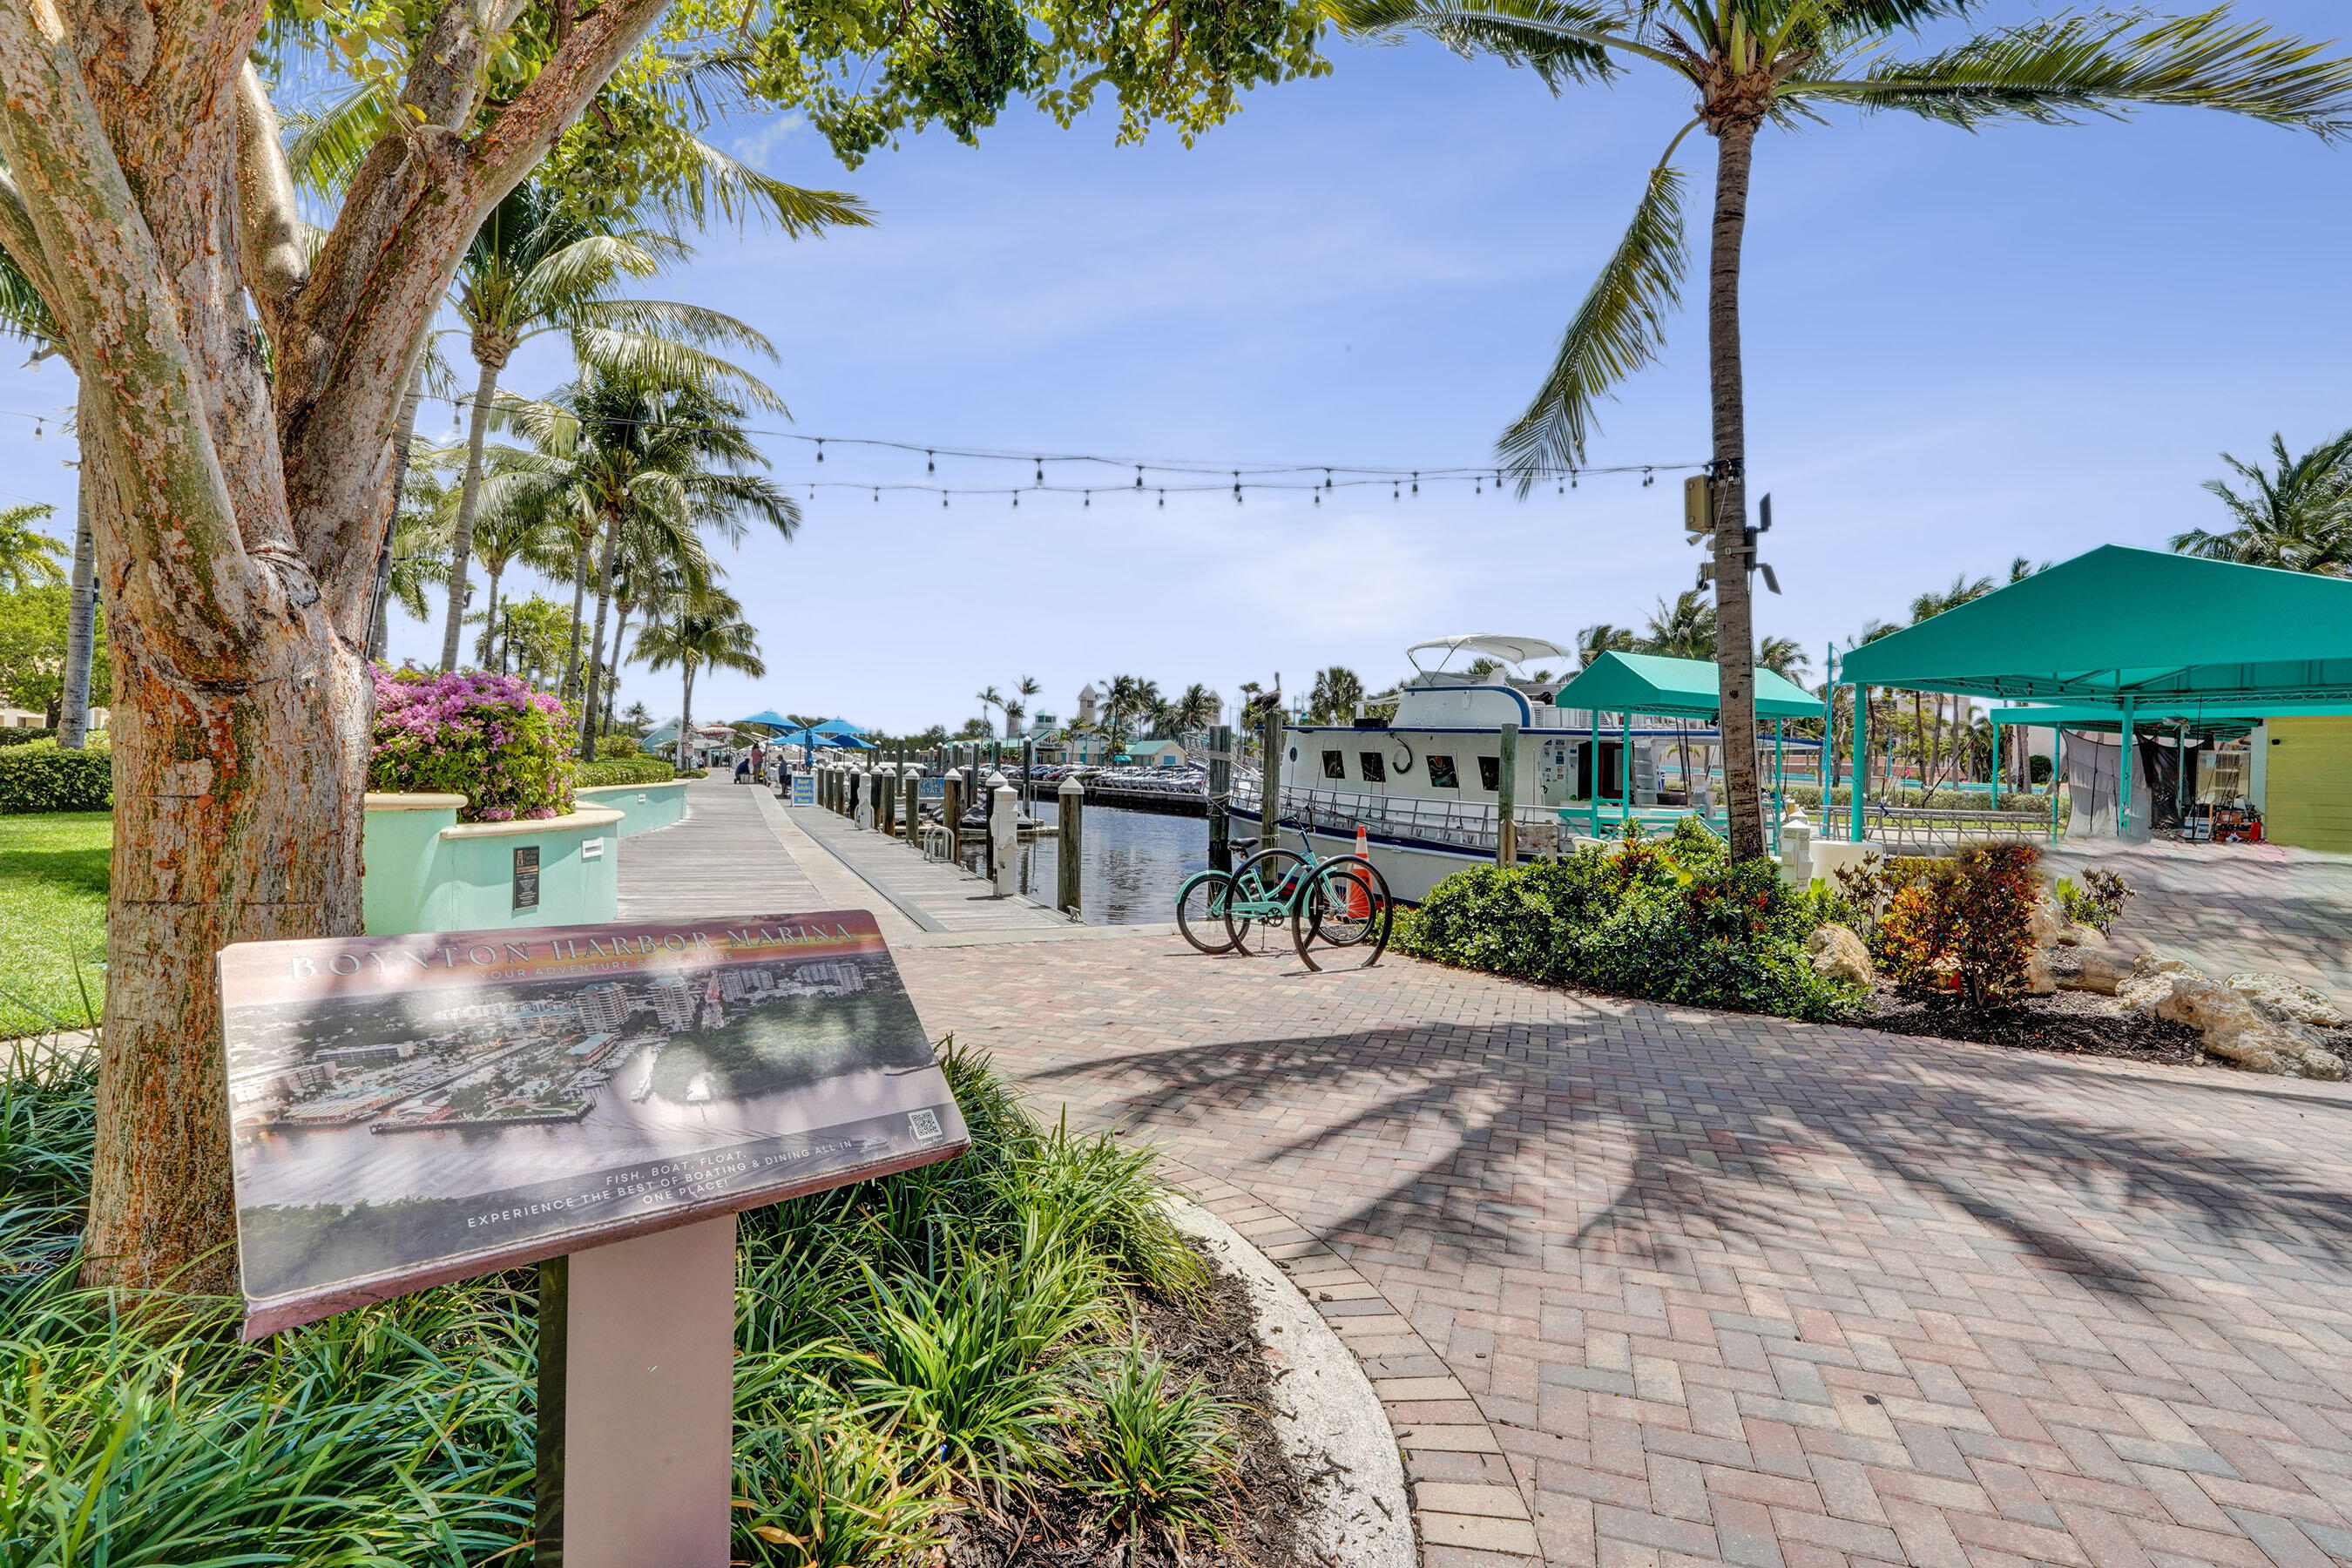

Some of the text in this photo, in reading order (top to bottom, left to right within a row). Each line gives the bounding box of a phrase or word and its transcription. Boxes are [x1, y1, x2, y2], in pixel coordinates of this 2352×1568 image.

[290, 923, 855, 979] BOYNTON HARBOR MARINA
[479, 968, 525, 981] YOUR
[535, 961, 629, 977] ADVENTURE
[698, 953, 733, 963] HERE
[468, 1139, 852, 1227] EXPERIENCE THE BEST OF BOATING & DINING ALL IN
[606, 1151, 747, 1185] FISH. BOAT. FLOAT.
[642, 1179, 729, 1204] ONE PLACE!
